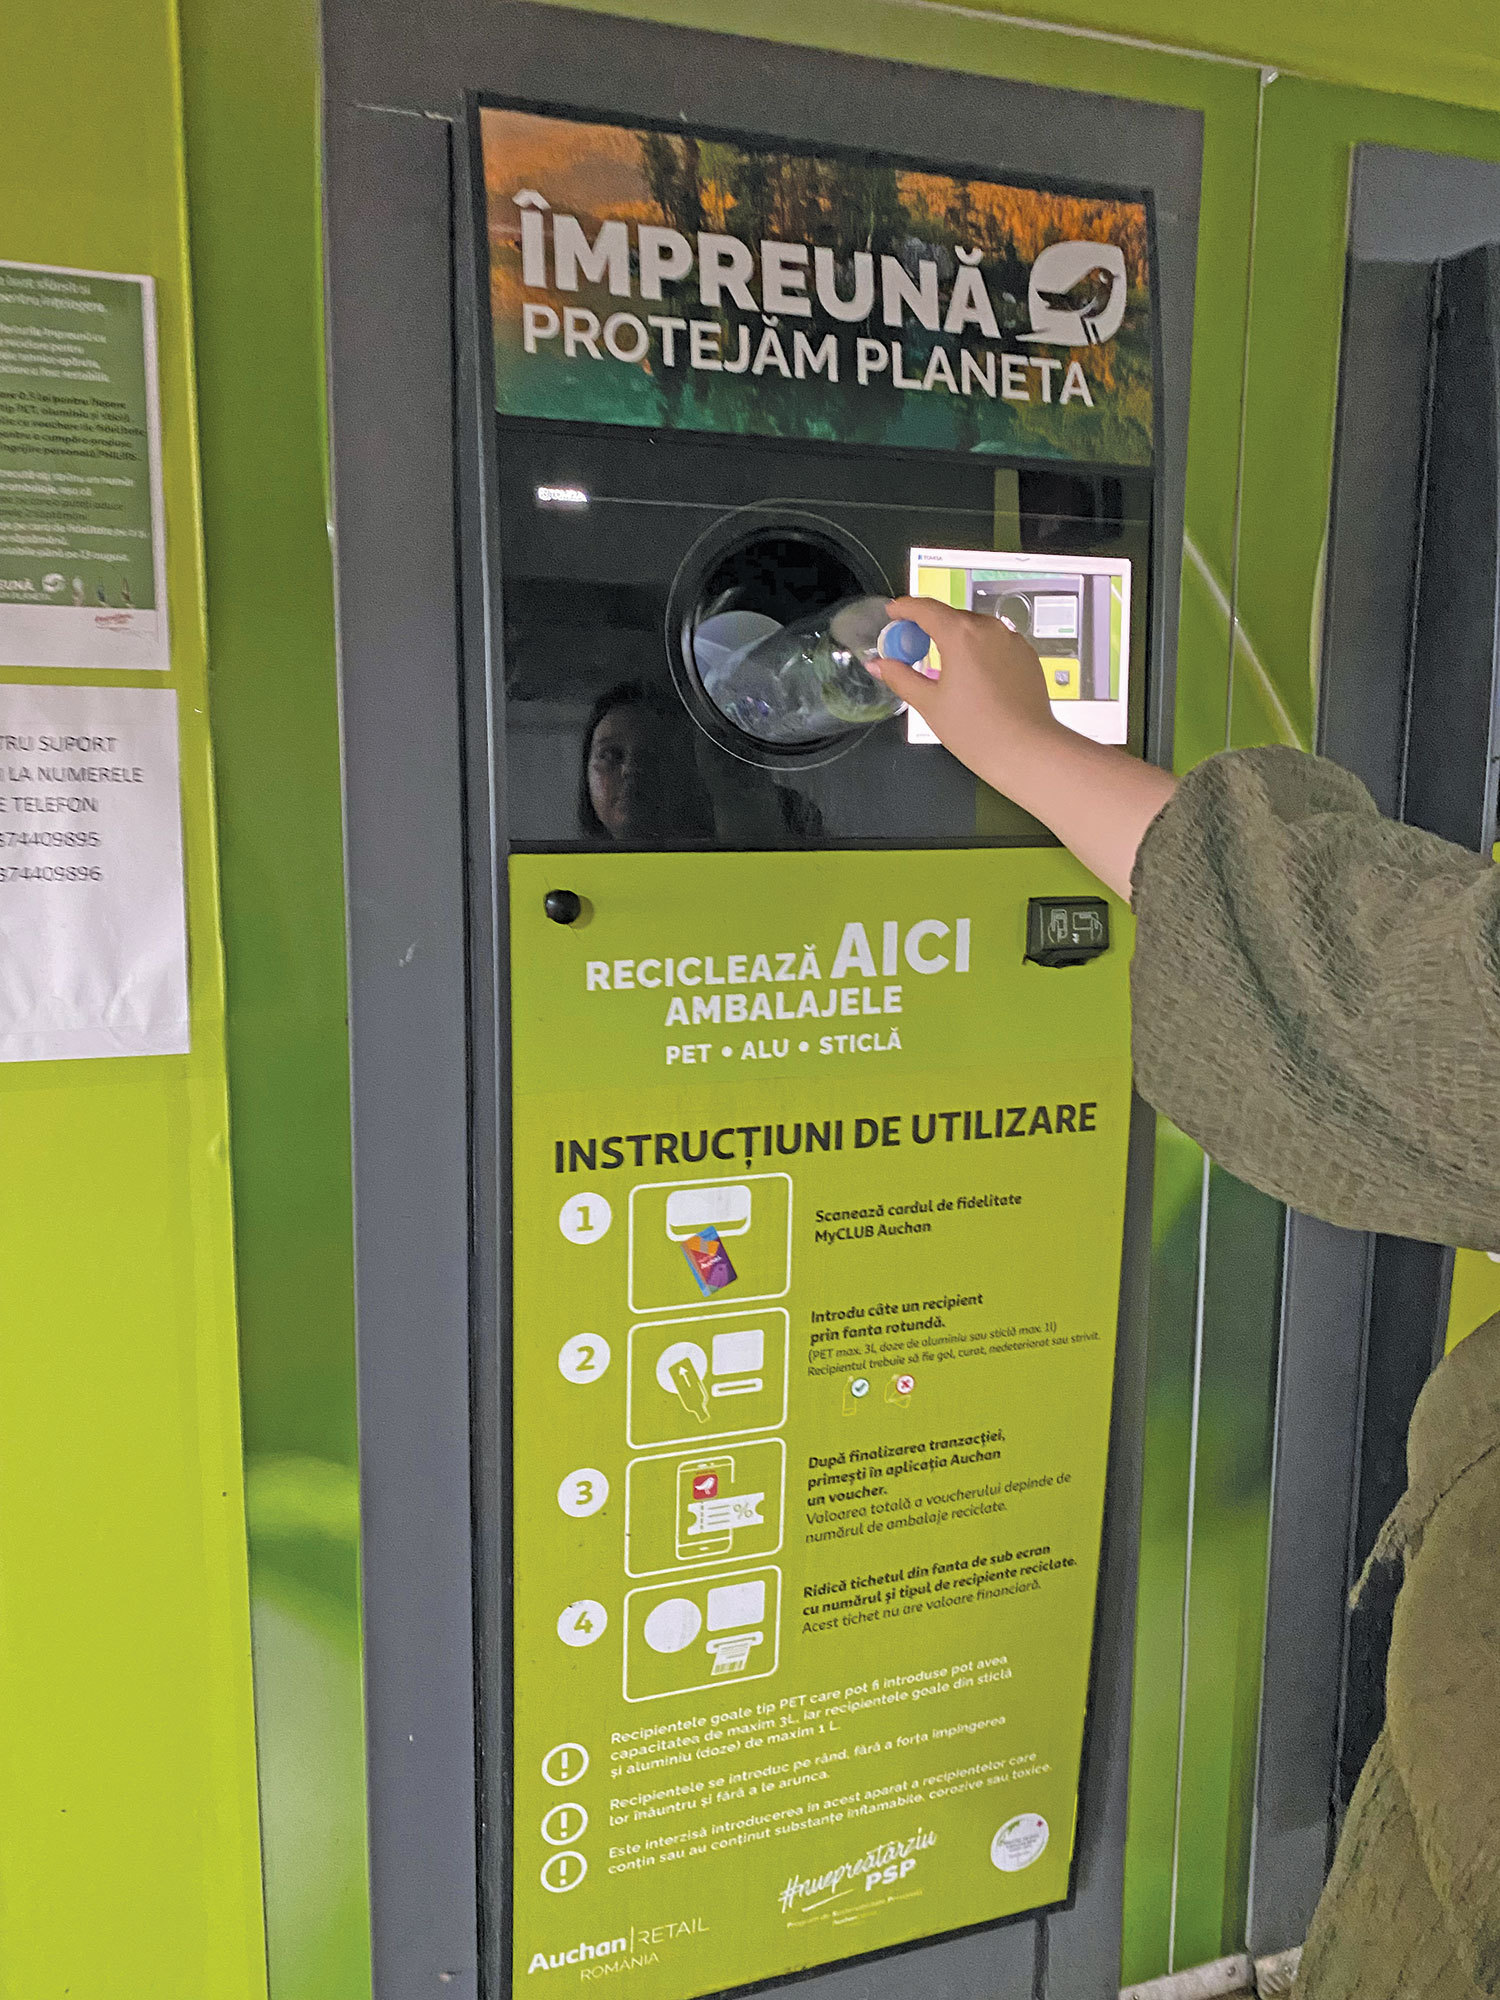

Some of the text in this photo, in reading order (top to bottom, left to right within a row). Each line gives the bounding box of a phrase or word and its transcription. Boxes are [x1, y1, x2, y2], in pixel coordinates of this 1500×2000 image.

[512, 189, 1001, 338] ÎMPREUNĂ
[523, 304, 1095, 408] PROTEJĂM PLANETA
[38, 735, 117, 752] SUPORT
[8, 766, 143, 783] LA NUMERELE
[11, 796, 99, 813] TELEFON
[585, 918, 972, 991] RECICLEAZĂ AICI
[665, 985, 903, 1027] AMBALAJELE
[666, 1028, 903, 1066] PET ALU STICLĂ
[555, 1102, 1098, 1174] INSTRUCȚIUNI DE UTILIZARE
[576, 1206, 595, 1232] 1
[815, 1194, 1022, 1223] Scanează cardul de fidelitate
[815, 1221, 931, 1245] MyCLUB Auchan
[811, 1293, 983, 1323] Introdu câte un recipient
[810, 1316, 945, 1346] prin fanta rotundă.
[576, 1346, 595, 1371] 2
[807, 1359, 867, 1376] Recipientul
[868, 1355, 905, 1369] trebuie
[907, 1353, 919, 1364] să
[921, 1351, 935, 1361] fie
[988, 1338, 1050, 1353] nedeteriorat
[1051, 1337, 1069, 1345] sau
[807, 1449, 1001, 1490] primești în aplicația Auchan
[808, 1452, 846, 1469] După
[848, 1443, 926, 1462] finalizarea
[576, 1481, 593, 1505] 3
[805, 1472, 1071, 1525] Valoarea totală a voucherului depinde de
[807, 1485, 887, 1506] un voucher.
[805, 1522, 864, 1543] numărul
[866, 1520, 883, 1533] de
[886, 1509, 948, 1530] ambalaje
[802, 1557, 1077, 1616] cu numărul și tipul de recipiente reciclate.
[803, 1546, 1050, 1598] Ridică tichetul din fanta de sub ecran
[574, 1611, 594, 1634] 4
[801, 1617, 838, 1634] Acest
[842, 1609, 880, 1626] tichet
[882, 1607, 899, 1618] nu
[902, 1603, 923, 1615] are
[926, 1594, 974, 1610] valoare
[610, 1735, 700, 1761] capacitatea
[704, 1724, 723, 1741] de
[727, 1719, 775, 1736] maxim
[803, 1710, 821, 1720] iar
[825, 1691, 909, 1716] recipientele
[911, 1682, 949, 1700] goale
[953, 1677, 973, 1689] din
[611, 1656, 1007, 1744] Recipientele goale tip PET care pot fi introduse pot avea
[610, 1724, 824, 1778] și aluminiu (doze) de maxim 1
[609, 1782, 704, 1810] Recipientele
[708, 1777, 725, 1788] se
[728, 1763, 789, 1784] introduc
[793, 1759, 811, 1772] pe
[884, 1741, 892, 1750] a
[896, 1733, 928, 1747] forța
[609, 1844, 641, 1859] Este
[711, 1807, 803, 1834] introducerea
[823, 1792, 860, 1809] acest
[864, 1780, 907, 1799] aparat
[911, 1780, 919, 1788] a
[923, 1760, 1005, 1785] recipientelor
[1009, 1753, 1036, 1765] care
[700, 1793, 712, 1808] și
[748, 1786, 757, 1795] a
[761, 1782, 775, 1792] le
[608, 1856, 655, 1874] conțin
[659, 1849, 685, 1862] sau
[688, 1844, 707, 1855] au
[710, 1828, 770, 1850] conținut
[775, 1812, 844, 1835] substanțe
[928, 1780, 983, 1799] corozive
[987, 1774, 1008, 1784] sau
[865, 1858, 916, 1891] PSP
[527, 1917, 710, 1974] Auchan RETAIL
